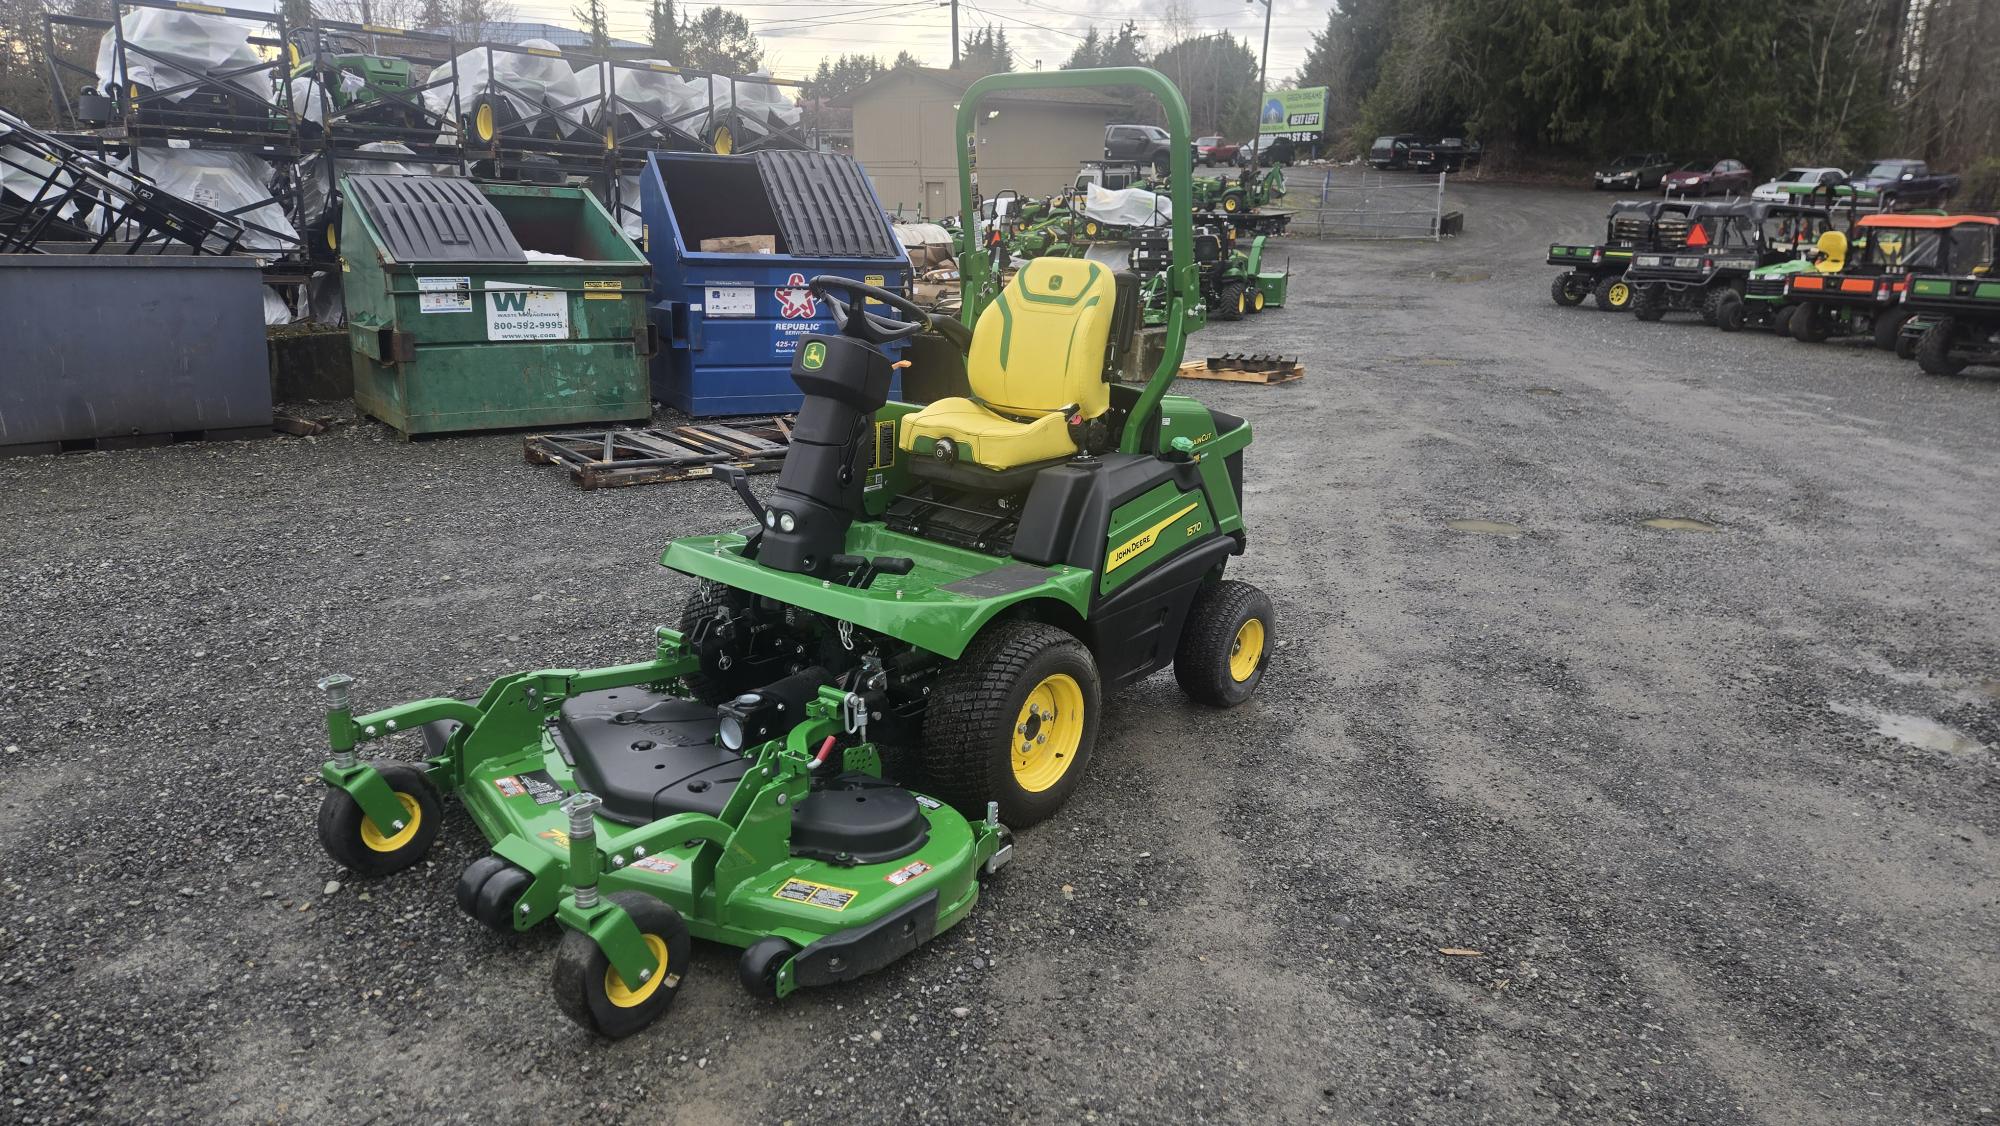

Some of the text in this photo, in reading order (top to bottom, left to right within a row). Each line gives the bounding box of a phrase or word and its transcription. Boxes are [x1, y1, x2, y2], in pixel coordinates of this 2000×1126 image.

[1291, 114, 1318, 125] NEXT LEFT
[1292, 133, 1301, 142] ST
[1302, 132, 1311, 142] SE
[494, 321, 563, 330] 800-592-9995
[775, 323, 820, 331] REPUBLIC
[1115, 534, 1151, 562] JOHN DEERE
